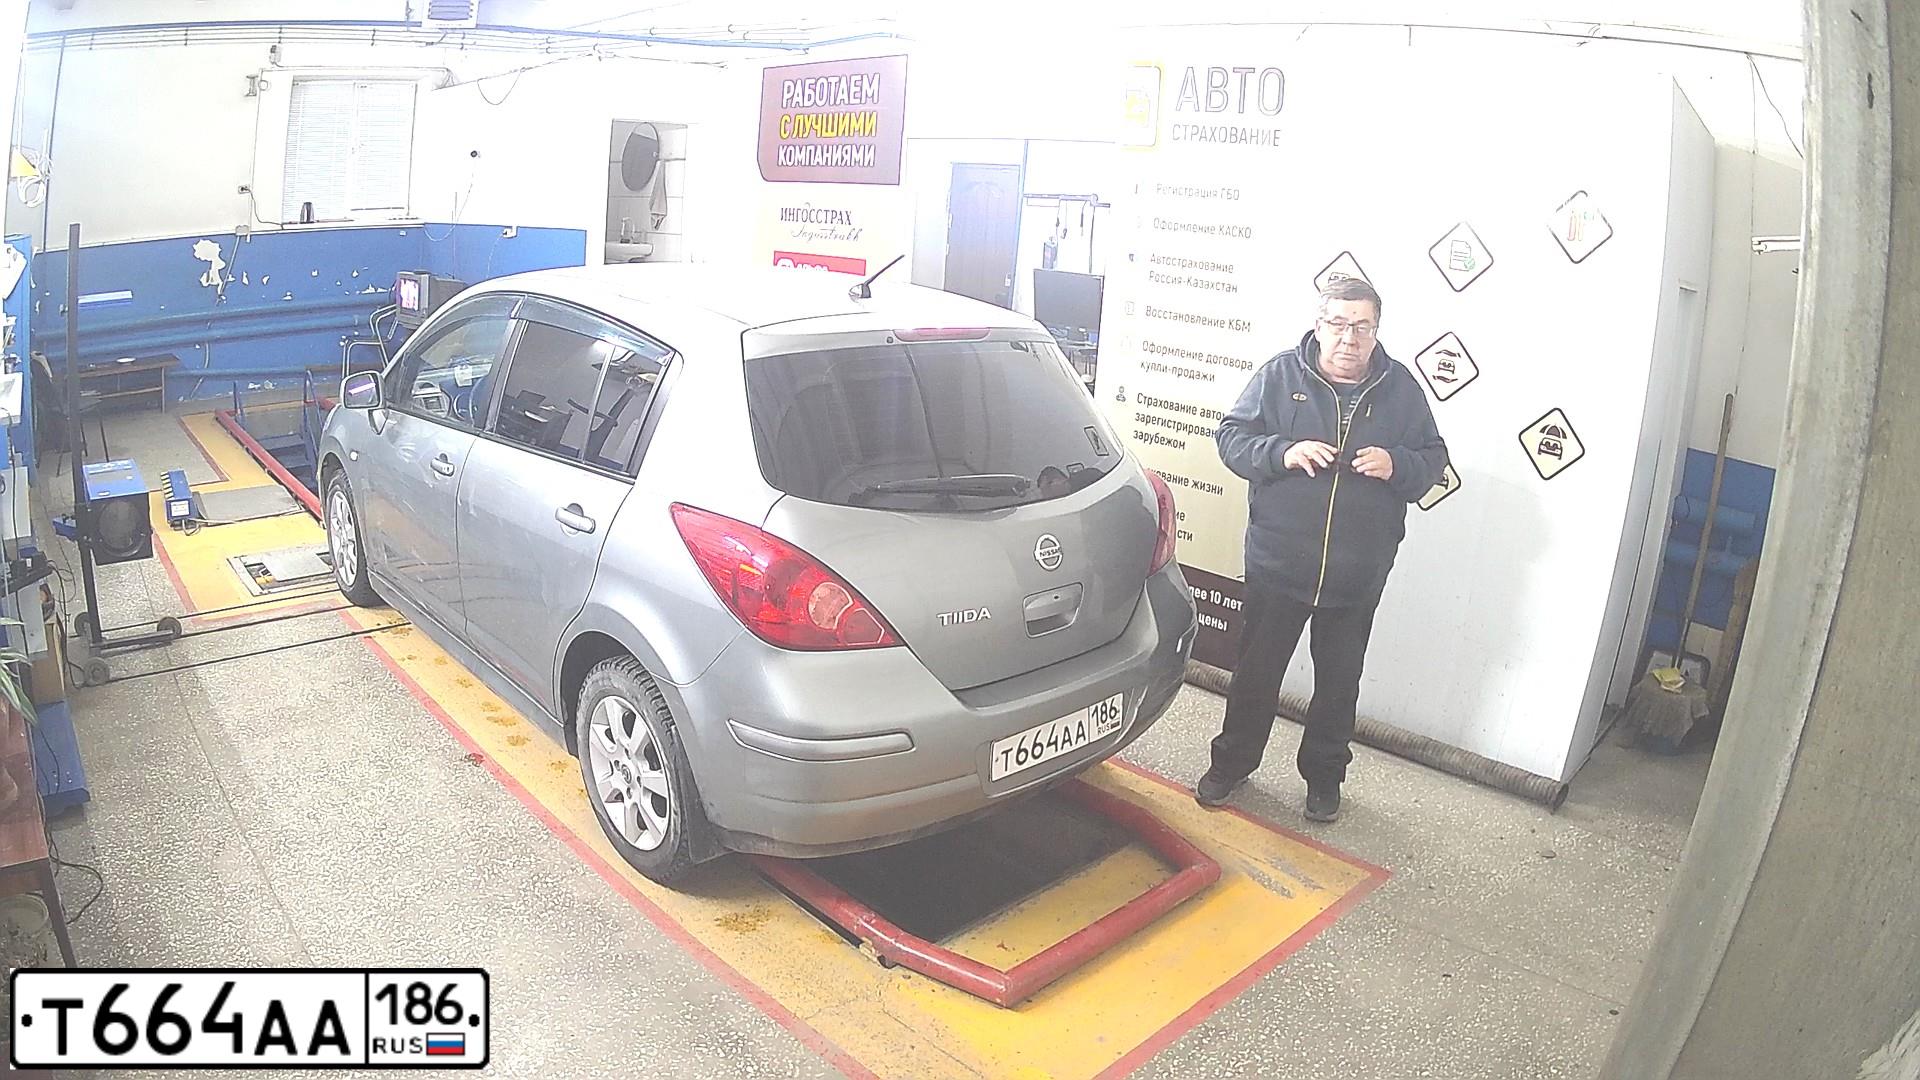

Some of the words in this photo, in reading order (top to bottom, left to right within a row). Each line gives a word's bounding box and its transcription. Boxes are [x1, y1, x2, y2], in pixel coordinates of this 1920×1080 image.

[781, 72, 881, 109] РАБОТАЕМ
[1175, 66, 1285, 117] АВТО
[779, 114, 791, 139] С
[792, 111, 879, 139] ЛУЧШИМИ
[1172, 124, 1281, 147] СТРАХОВАНИЕ
[777, 144, 876, 168] КОМПАНИЯМИ
[1156, 183, 1218, 199] Регистрация
[1220, 187, 1240, 200] ГБО
[780, 205, 852, 225] ИНГОССТРАХ
[1153, 217, 1216, 235] Оформление
[1218, 224, 1252, 239] КАСКО
[1150, 253, 1234, 274] Автострахование
[1149, 270, 1238, 293] Россия-Казахстан
[1145, 305, 1225, 329] Восстановление
[1228, 319, 1251, 333] КБМ
[1142, 340, 1204, 362] Оформление
[1205, 353, 1253, 371] договора
[1140, 360, 1215, 382] купли-продажи
[1137, 392, 1198, 416] Страхование
[1199, 407, 1225, 421] авто
[1133, 430, 1186, 451] зарубежом
[1191, 479, 1223, 496] жизни
[1209, 589, 1222, 605] 10
[1222, 596, 1243, 611] лет
[937, 607, 991, 627] TIIDA
[1198, 612, 1228, 632] цены
[1001, 720, 1087, 772] Т664АА
[1091, 697, 1118, 727] 186
[1097, 722, 1111, 736] RUS
